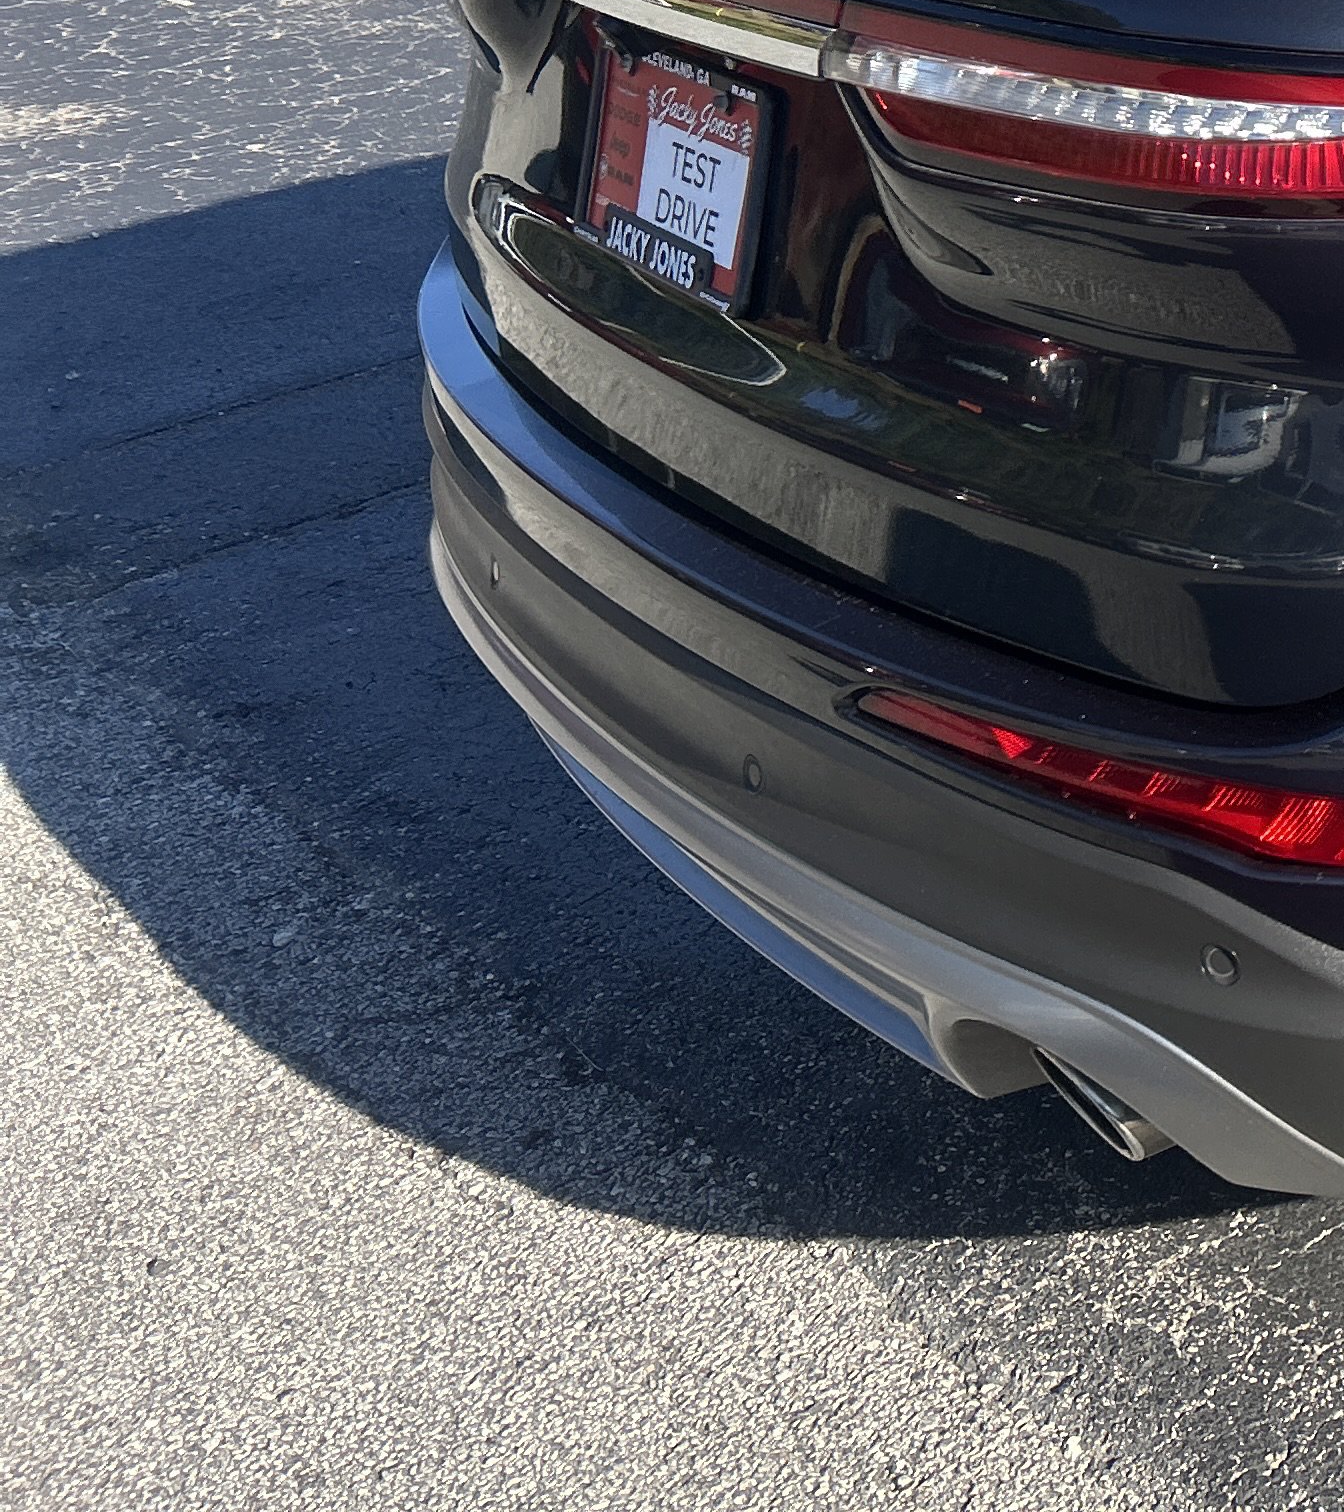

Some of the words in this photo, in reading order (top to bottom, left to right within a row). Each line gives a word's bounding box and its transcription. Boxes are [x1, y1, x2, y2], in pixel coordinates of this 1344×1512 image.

[658, 87, 699, 138] Jacky
[697, 103, 738, 142] Jones
[672, 141, 722, 193] TEST
[654, 188, 720, 249] DRIVE
[606, 216, 652, 264] JACKY
[649, 239, 696, 289] JONES
